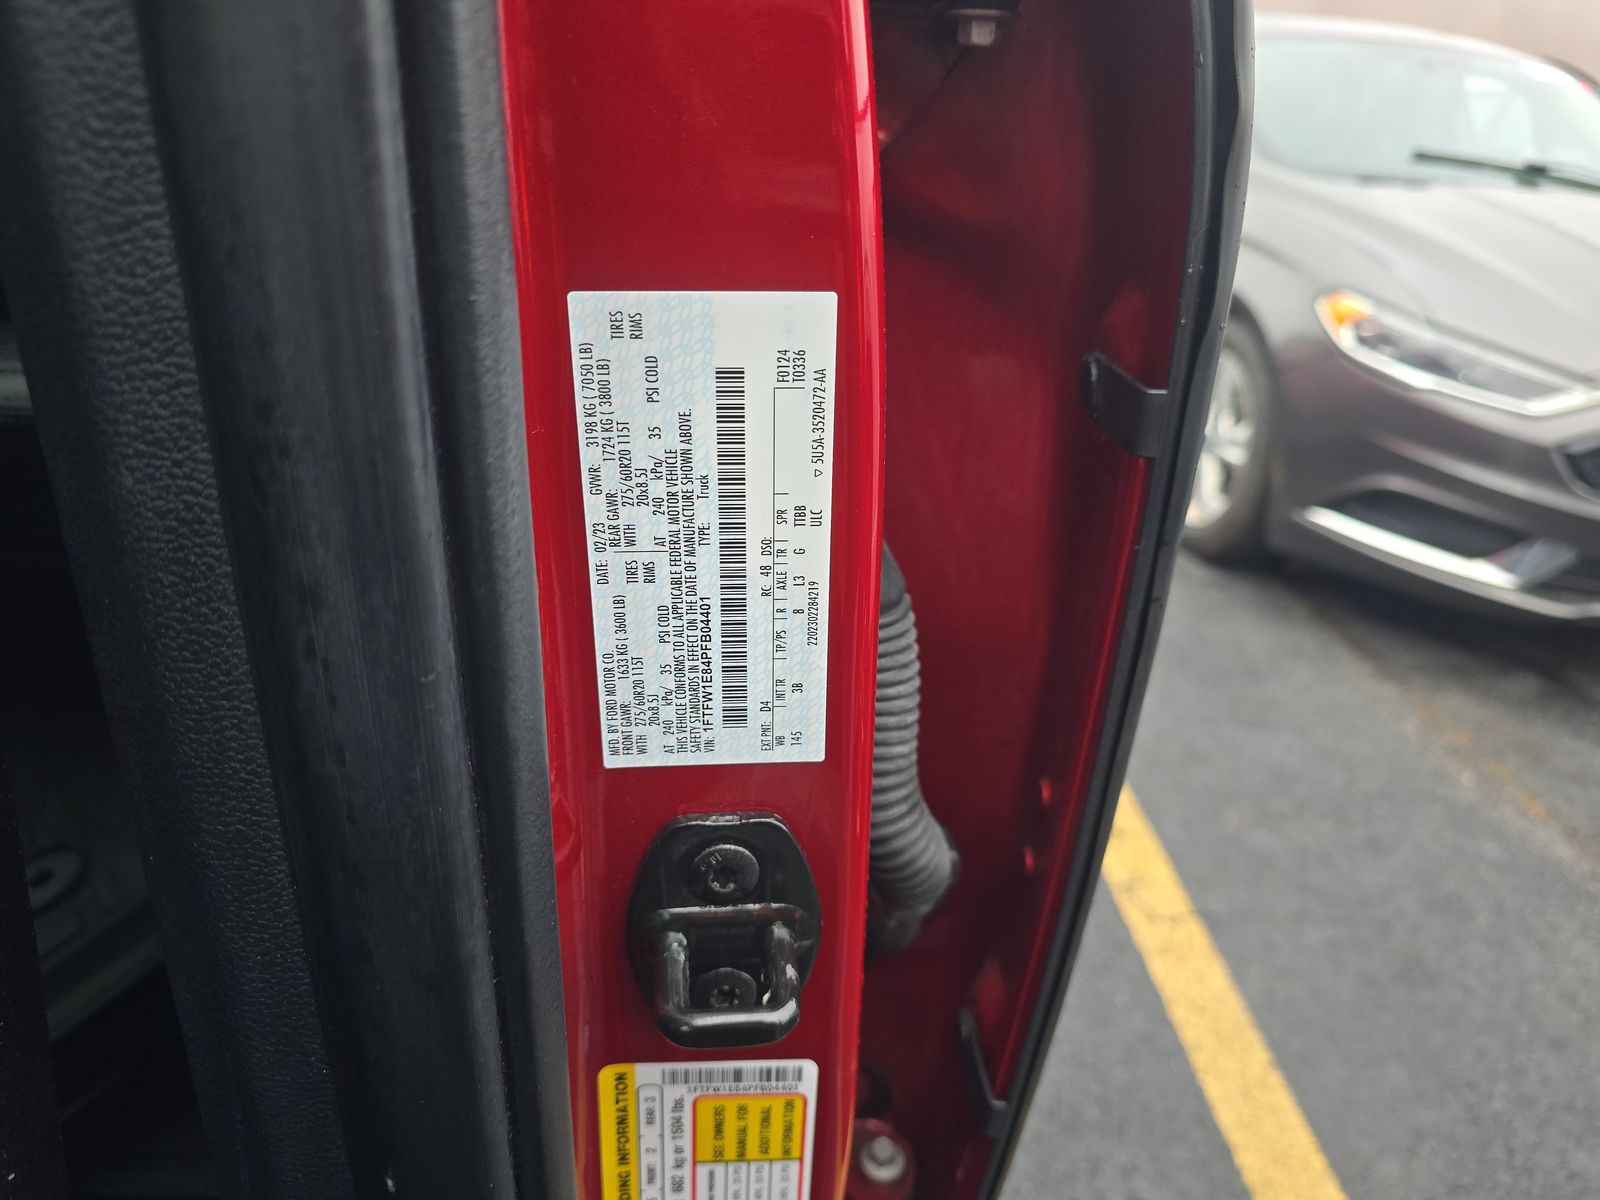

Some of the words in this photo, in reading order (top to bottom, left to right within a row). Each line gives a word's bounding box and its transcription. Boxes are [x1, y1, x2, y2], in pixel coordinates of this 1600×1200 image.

[610, 311, 624, 339] TIRES
[629, 313, 643, 339] RIMS
[579, 342, 593, 359] LB)
[596, 359, 610, 375] LB)
[645, 356, 658, 383] COLD
[777, 350, 790, 382] F0124
[792, 350, 806, 382] T0336
[581, 364, 595, 391] 7050
[598, 380, 612, 407] 3800
[646, 387, 659, 403] PSI
[583, 403, 596, 417] KG
[585, 422, 599, 447] 3198
[601, 419, 614, 432] KG
[616, 421, 631, 445] 115T
[649, 426, 662, 439] 35
[678, 409, 692, 445] ABOVE.
[602, 437, 615, 462] 1724
[649, 455, 664, 480] kPa/
[665, 449, 678, 487] VEHICLE
[680, 449, 693, 485] SHOWN
[589, 464, 602, 495] GVWR:
[619, 450, 635, 507] 275/60R20
[635, 468, 649, 507] 20x8.5J
[696, 475, 710, 499] Truck
[606, 489, 620, 520] GAWR:
[653, 498, 665, 515] 240
[666, 491, 680, 525] MOTOR
[681, 489, 696, 557] MANUFACTURE
[777, 509, 788, 525] SPR
[794, 505, 807, 527] TTBB
[810, 510, 823, 526] ULC
[592, 523, 608, 552] 02/23
[608, 524, 621, 547] REAR
[623, 525, 636, 547] WITH
[654, 536, 666, 546] AT
[698, 523, 711, 546] TYPE:
[668, 528, 681, 566] FEDERAL
[761, 537, 772, 556] DSO:
[777, 549, 788, 558] TR
[596, 560, 609, 584] DATE:
[625, 560, 639, 584] TIRES
[643, 562, 655, 584] RIMS
[684, 560, 696, 571] OF
[760, 565, 771, 577] 48
[685, 575, 697, 596] DATE
[761, 585, 771, 596] RC:
[776, 571, 787, 590] AXLE
[793, 576, 805, 586] L3
[612, 595, 626, 609] LB)
[670, 570, 683, 620] APPLICABLE
[657, 606, 669, 627] COLD
[685, 600, 697, 615] THE
[807, 581, 819, 646] 2202302284219
[614, 612, 627, 634] 3600
[672, 624, 684, 638] ALL
[686, 619, 698, 630] ON
[658, 631, 671, 643] PSI
[672, 641, 684, 652] TO
[686, 633, 698, 661] EFFECT
[775, 630, 787, 652] TP/PS
[602, 650, 614, 664] CO.
[616, 644, 628, 655] KG
[617, 659, 629, 679] 1633
[631, 656, 644, 676] 115T
[660, 664, 672, 675] 35
[687, 665, 699, 673] IN
[699, 596, 713, 732] 1FTFW1E84PFB04401
[603, 667, 616, 696] MOTOR
[673, 655, 686, 699] CONFORMS
[776, 679, 786, 688] TR
[660, 686, 675, 706] kPa/
[775, 690, 786, 701] INT
[792, 683, 803, 693] 3B
[606, 700, 618, 720] FORD
[632, 680, 646, 726] 275/60R20
[647, 694, 660, 726] 20x8.5J
[688, 676, 701, 724] STANDARDS
[760, 701, 771, 712] D4
[620, 701, 632, 727] GAWR:
[675, 703, 687, 734] VEHICLE
[608, 724, 619, 733] BY
[663, 720, 674, 735] 240
[761, 721, 771, 737] PNT:
[609, 737, 620, 756] MFD.
[621, 730, 633, 755] FRONT
[636, 735, 648, 755] WITH
[664, 745, 675, 753] AT
[676, 737, 689, 753] THIS
[690, 726, 702, 753] SAFETY
[704, 737, 715, 753] VIN:
[761, 738, 771, 751] EXT
[775, 735, 785, 746] WB
[791, 732, 802, 746] 145
[671, 1095, 684, 1112] lbs.
[737, 1103, 748, 1120] FOR
[615, 1072, 630, 1166] INFORMATION
[671, 1116, 684, 1140] 1504
[783, 1099, 795, 1155] INFORMATION
[760, 1105, 771, 1154] ADDITIONAL
[675, 1145, 684, 1153] or
[713, 1143, 724, 1158] SEE
[737, 1124, 747, 1158] MANUAL
[672, 1157, 687, 1169] kg
[671, 1175, 684, 1192] 682
